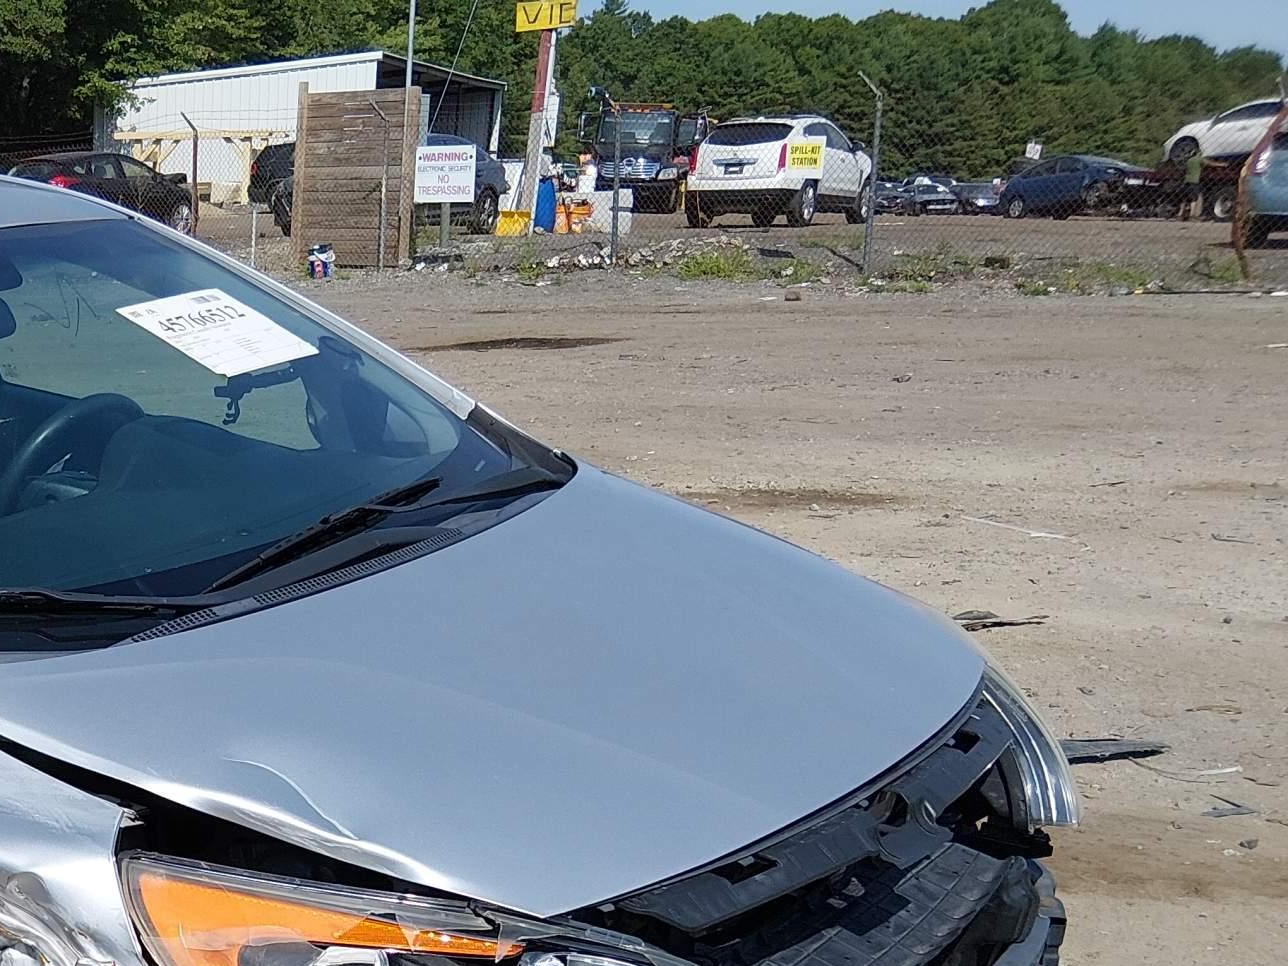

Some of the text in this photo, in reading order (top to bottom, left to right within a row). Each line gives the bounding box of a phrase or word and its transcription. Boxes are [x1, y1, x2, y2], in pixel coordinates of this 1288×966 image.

[422, 152, 468, 162] WARNING
[791, 157, 818, 166] STATION
[437, 174, 450, 184] NO
[417, 185, 471, 196] TRESPASSING
[158, 304, 246, 333] 45766512
